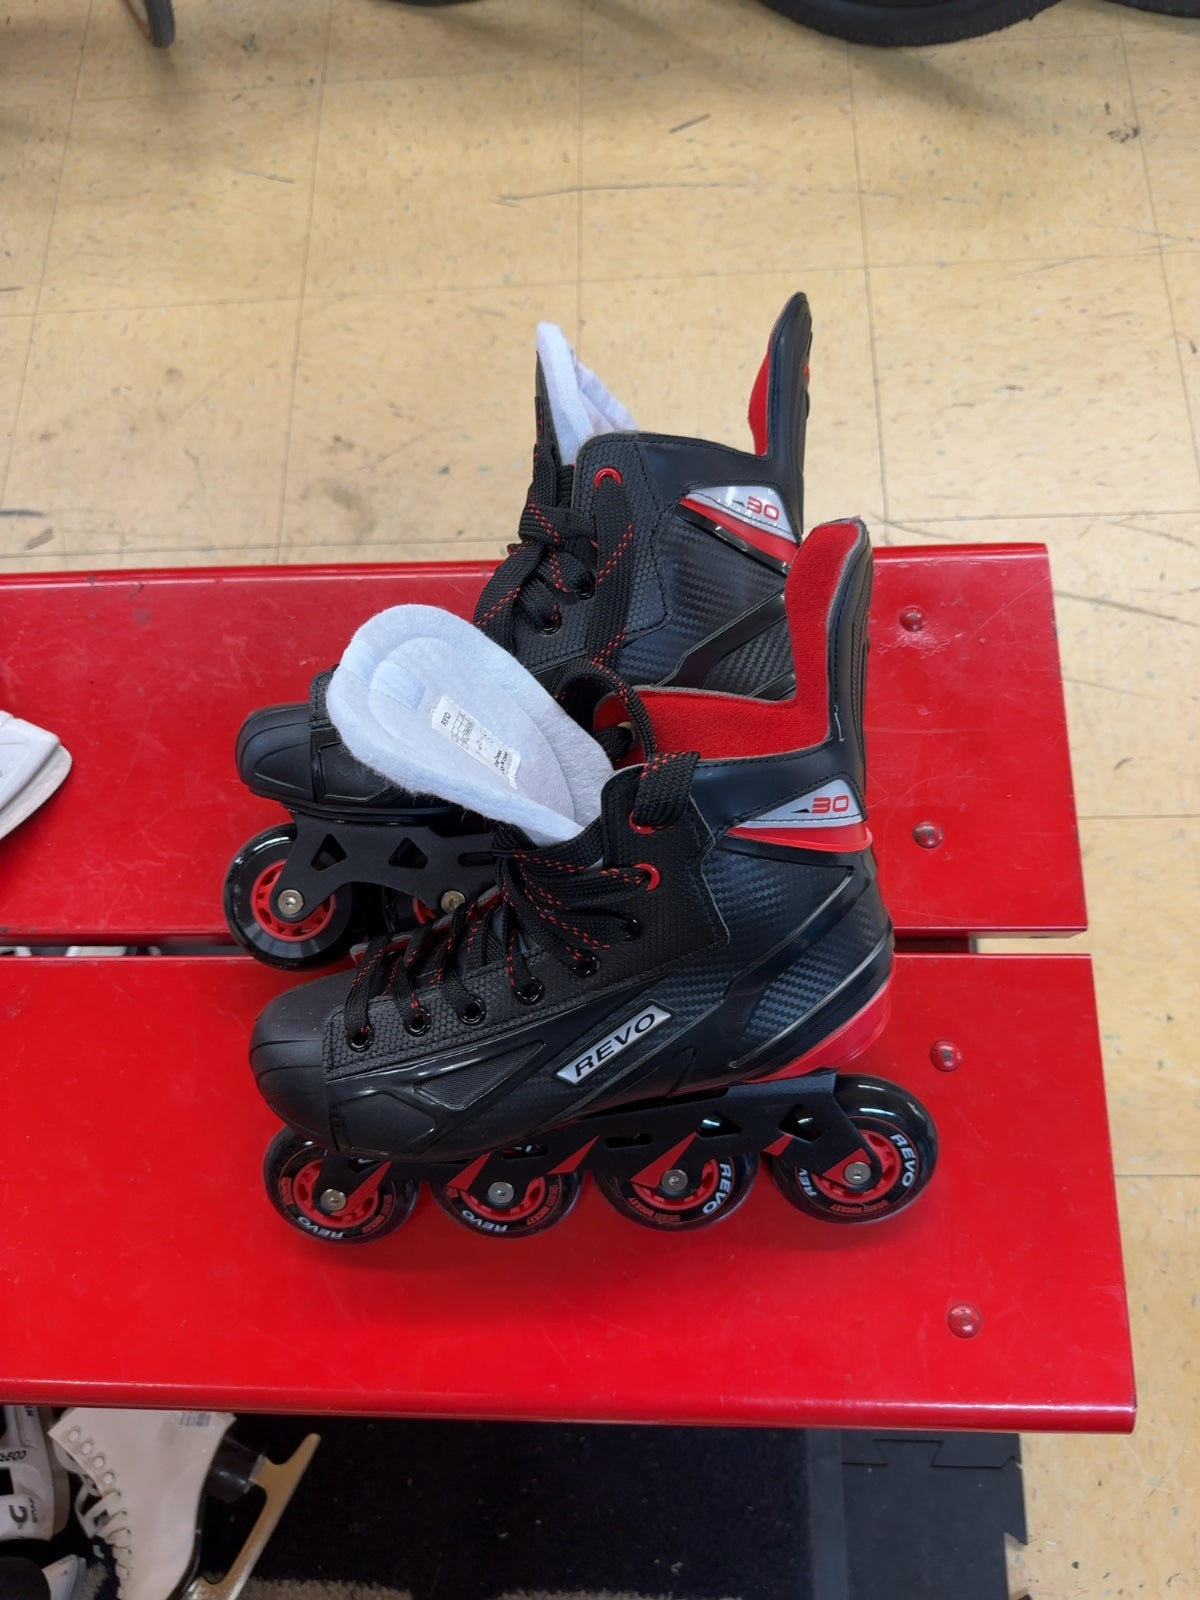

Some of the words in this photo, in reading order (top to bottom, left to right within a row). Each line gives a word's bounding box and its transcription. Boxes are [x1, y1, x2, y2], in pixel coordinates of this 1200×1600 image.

[747, 496, 780, 521] 30
[811, 794, 850, 814] 30
[574, 1013, 655, 1078] REVO
[890, 1134, 916, 1187] REVO
[702, 1163, 732, 1214] REVO
[798, 1167, 818, 1197] REV
[298, 1216, 344, 1239] REVO
[462, 1209, 508, 1232] REVO
